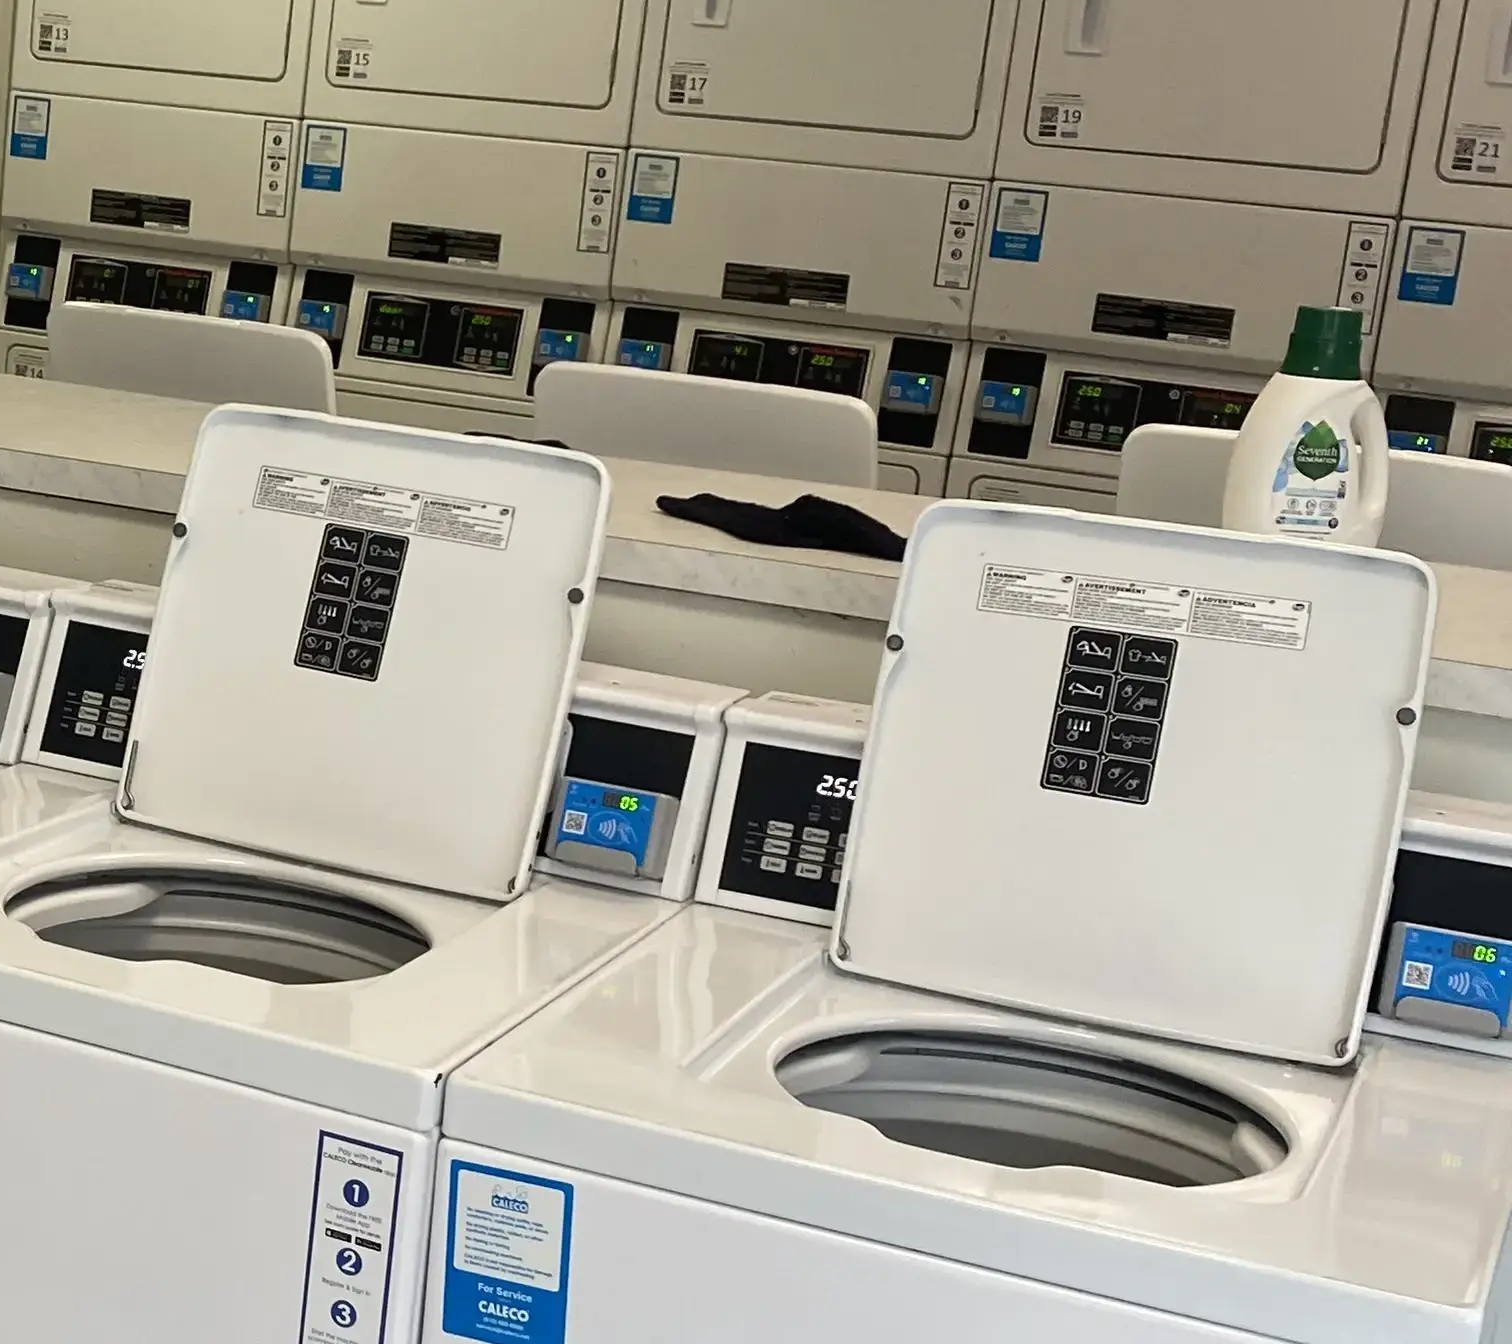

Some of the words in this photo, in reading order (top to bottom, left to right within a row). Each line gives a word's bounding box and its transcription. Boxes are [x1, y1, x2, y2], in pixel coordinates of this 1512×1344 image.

[56, 28, 68, 40] 13
[354, 53, 370, 66] 15
[689, 78, 707, 90] 17
[1062, 110, 1081, 123] 19
[1478, 142, 1499, 158] 21
[1298, 445, 1338, 456] Seventh
[993, 572, 1027, 580] WARNING
[620, 796, 639, 811] 05
[1473, 945, 1497, 963] 06
[323, 1152, 347, 1163] CALECO
[338, 1147, 351, 1157] Pay
[353, 1152, 369, 1161] with
[370, 1156, 382, 1165] the
[351, 1184, 360, 1203] 1
[493, 1198, 527, 1211] CALECO
[341, 1250, 356, 1272] 2
[478, 1282, 493, 1293] For
[496, 1287, 532, 1303] Service
[336, 1303, 351, 1325] 3
[478, 1300, 529, 1322] CALECO
